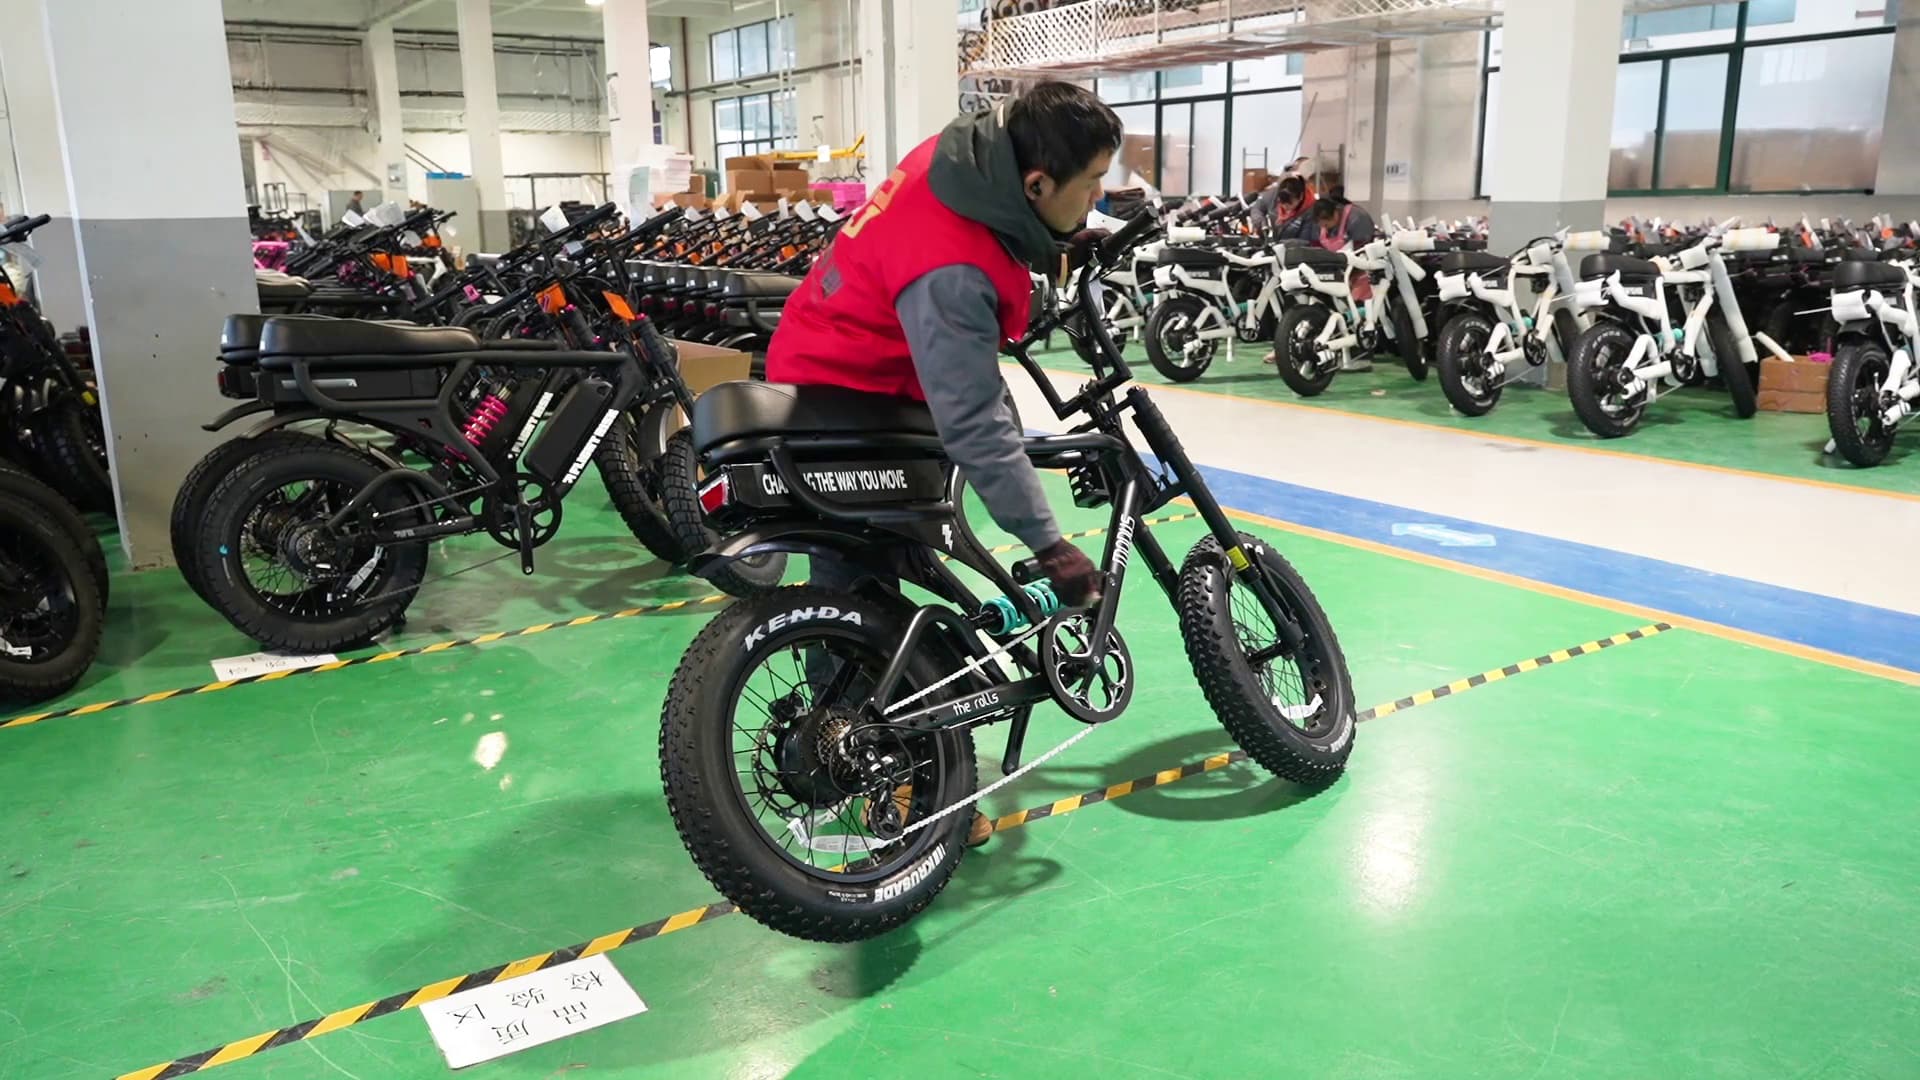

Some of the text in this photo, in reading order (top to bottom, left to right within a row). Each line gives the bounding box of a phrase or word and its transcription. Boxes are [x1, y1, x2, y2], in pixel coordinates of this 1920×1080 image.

[813, 471, 838, 493] THE
[834, 471, 858, 491] WAY
[855, 470, 880, 491] YOU
[878, 469, 908, 490] MOVE
[744, 606, 862, 652] KENDA
[953, 692, 999, 716] the rolls
[446, 970, 603, 1029] 检验区
[491, 1001, 588, 1045] 品质
